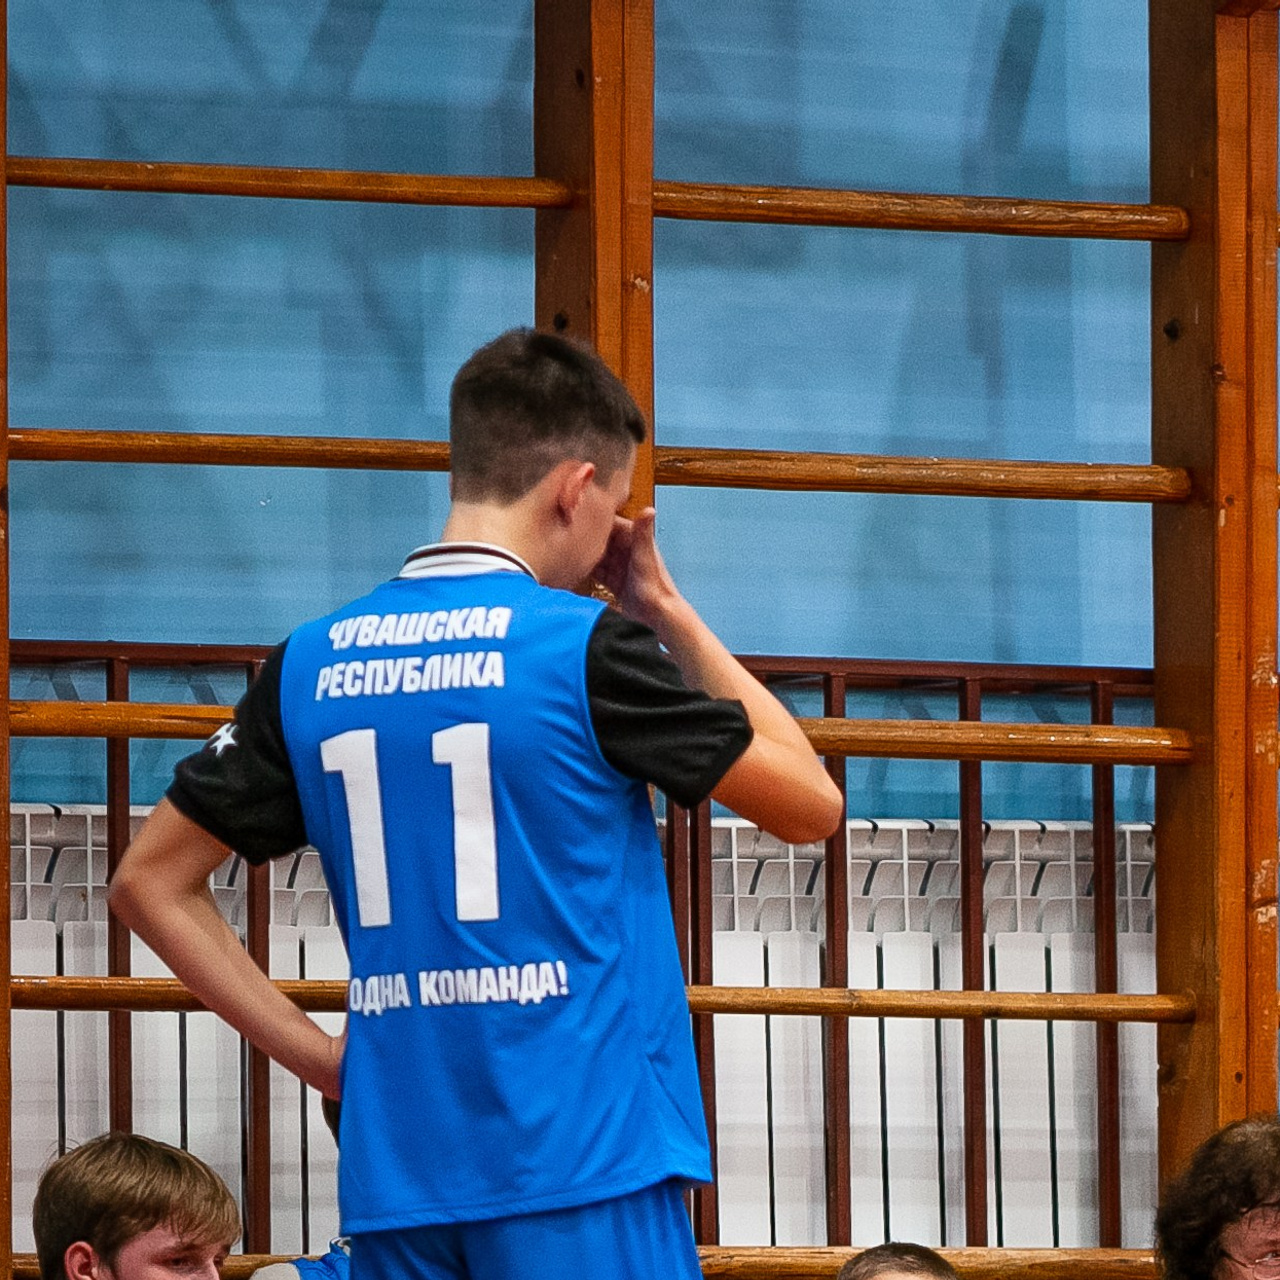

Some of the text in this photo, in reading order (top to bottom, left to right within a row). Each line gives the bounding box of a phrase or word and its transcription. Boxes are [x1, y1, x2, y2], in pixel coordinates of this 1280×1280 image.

[328, 606, 512, 651] ЧУВАШСКАЯ
[315, 650, 505, 702] РЕСПУБЛИКА
[319, 722, 501, 928] 11
[348, 960, 570, 1016] ОДНА КОМАНДА!
